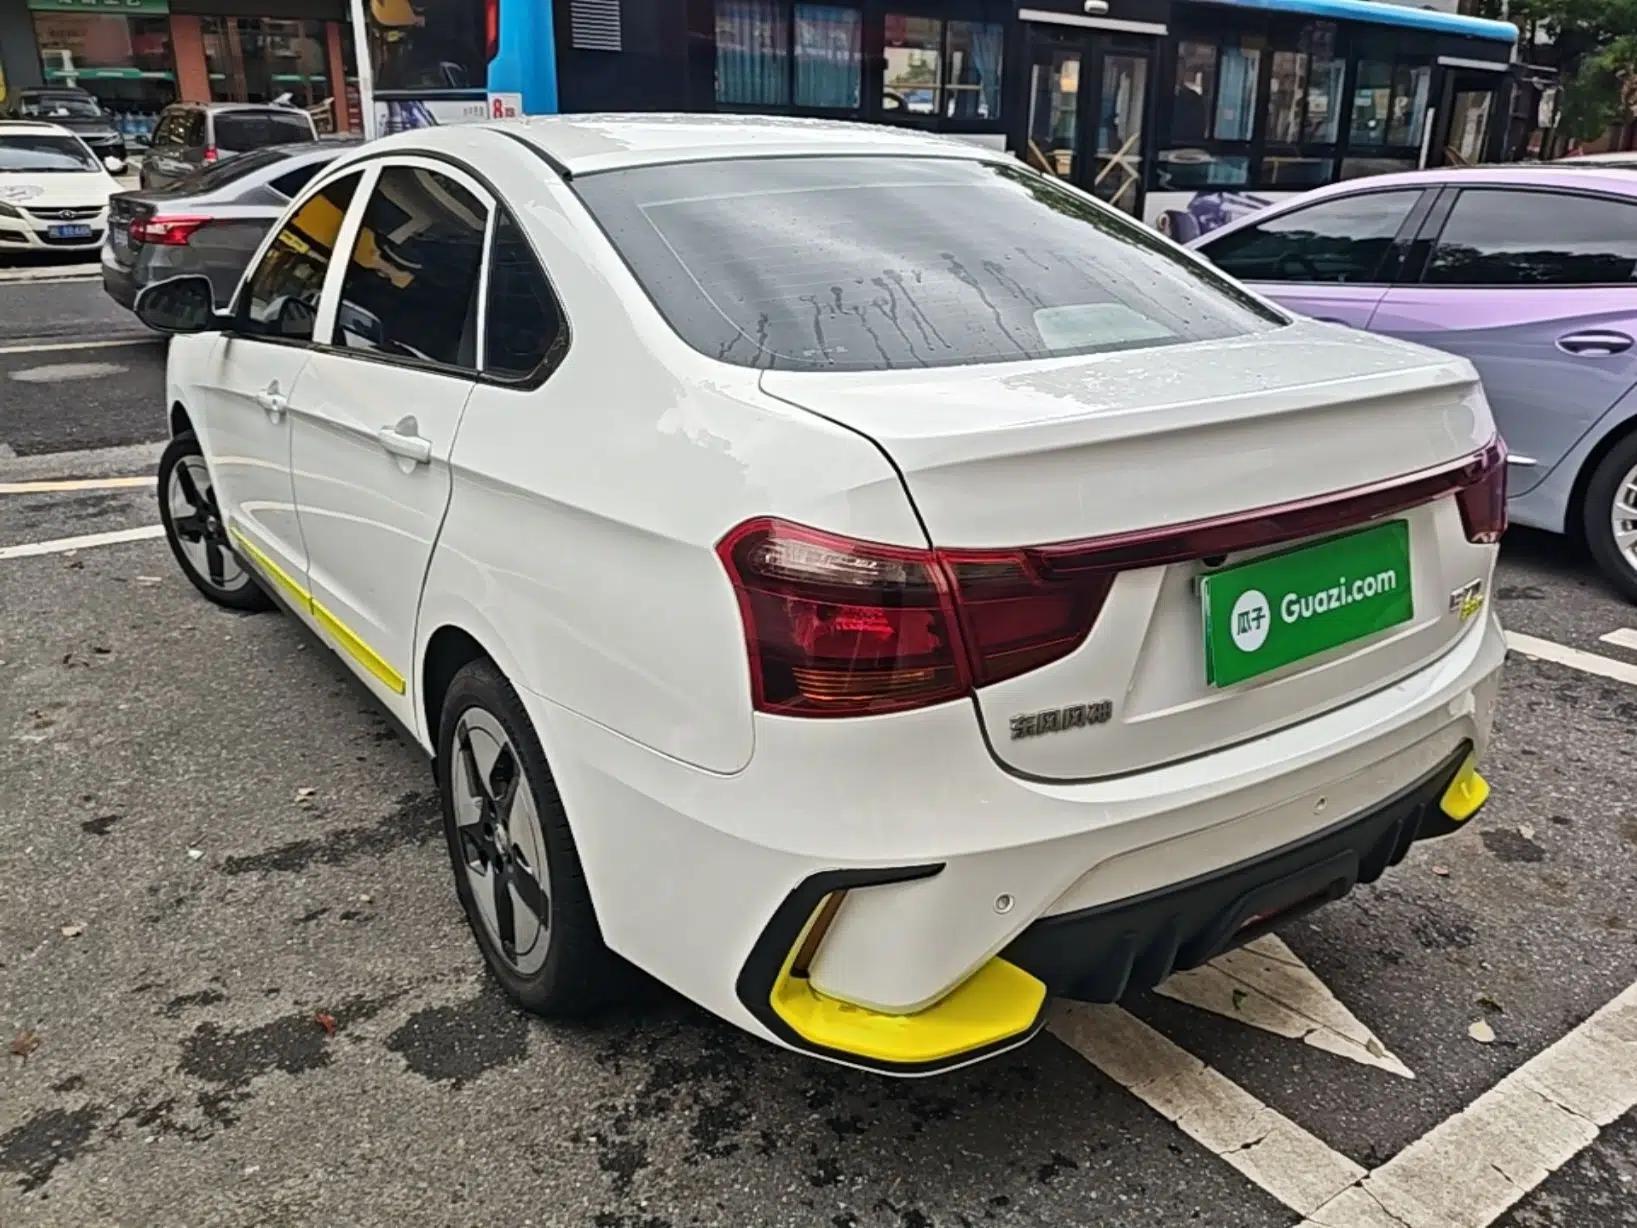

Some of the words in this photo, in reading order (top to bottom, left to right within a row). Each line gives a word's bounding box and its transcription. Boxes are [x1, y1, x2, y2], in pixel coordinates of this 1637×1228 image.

[1237, 606, 1266, 635] 瓜子
[1281, 570, 1396, 623] Guazi.com
[1009, 699, 1113, 740] 东风风神
